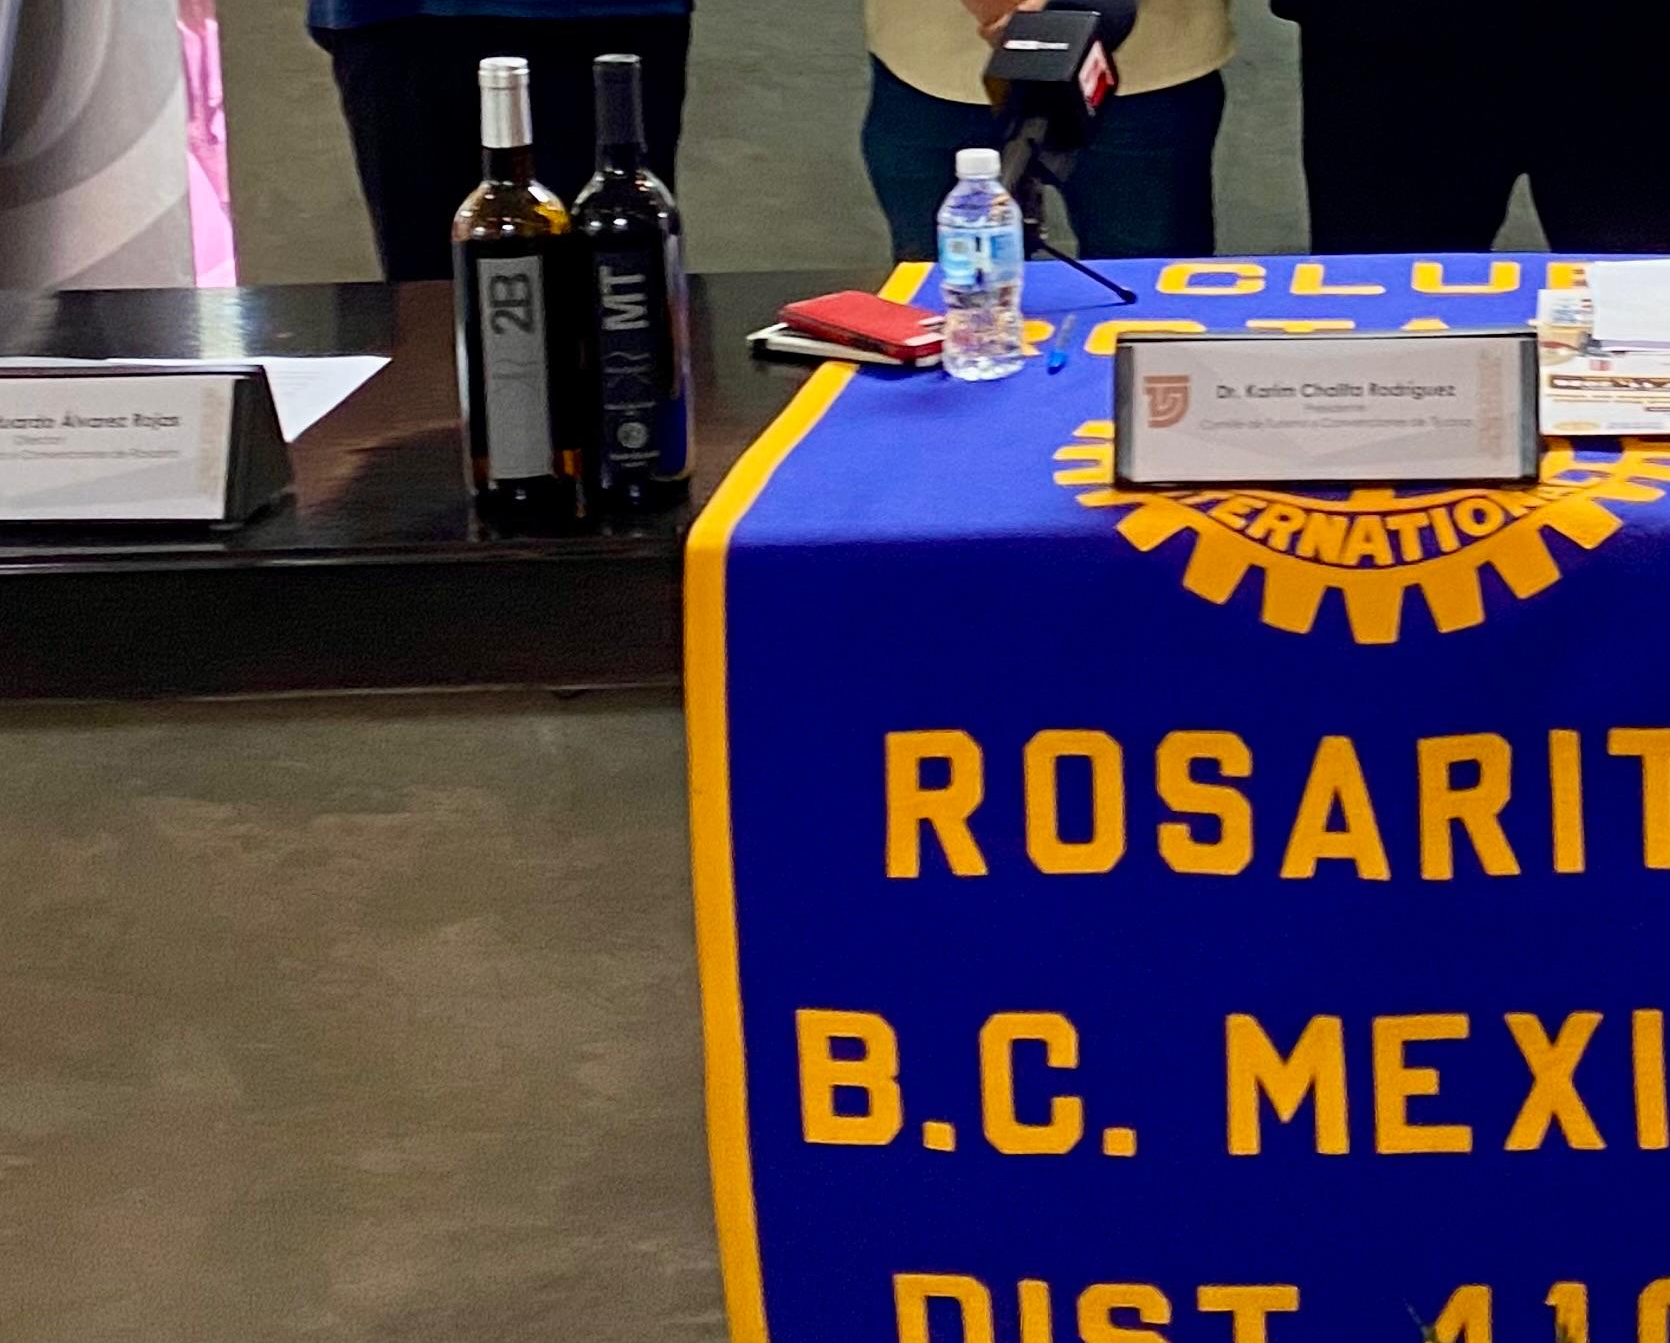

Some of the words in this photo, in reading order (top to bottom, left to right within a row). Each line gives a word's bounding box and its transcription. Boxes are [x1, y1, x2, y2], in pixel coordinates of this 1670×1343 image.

[599, 265, 649, 331] MT
[1216, 384, 1241, 399] Dr.
[1245, 383, 1297, 399] Karim
[796, 1009, 1138, 1156] B.C.
